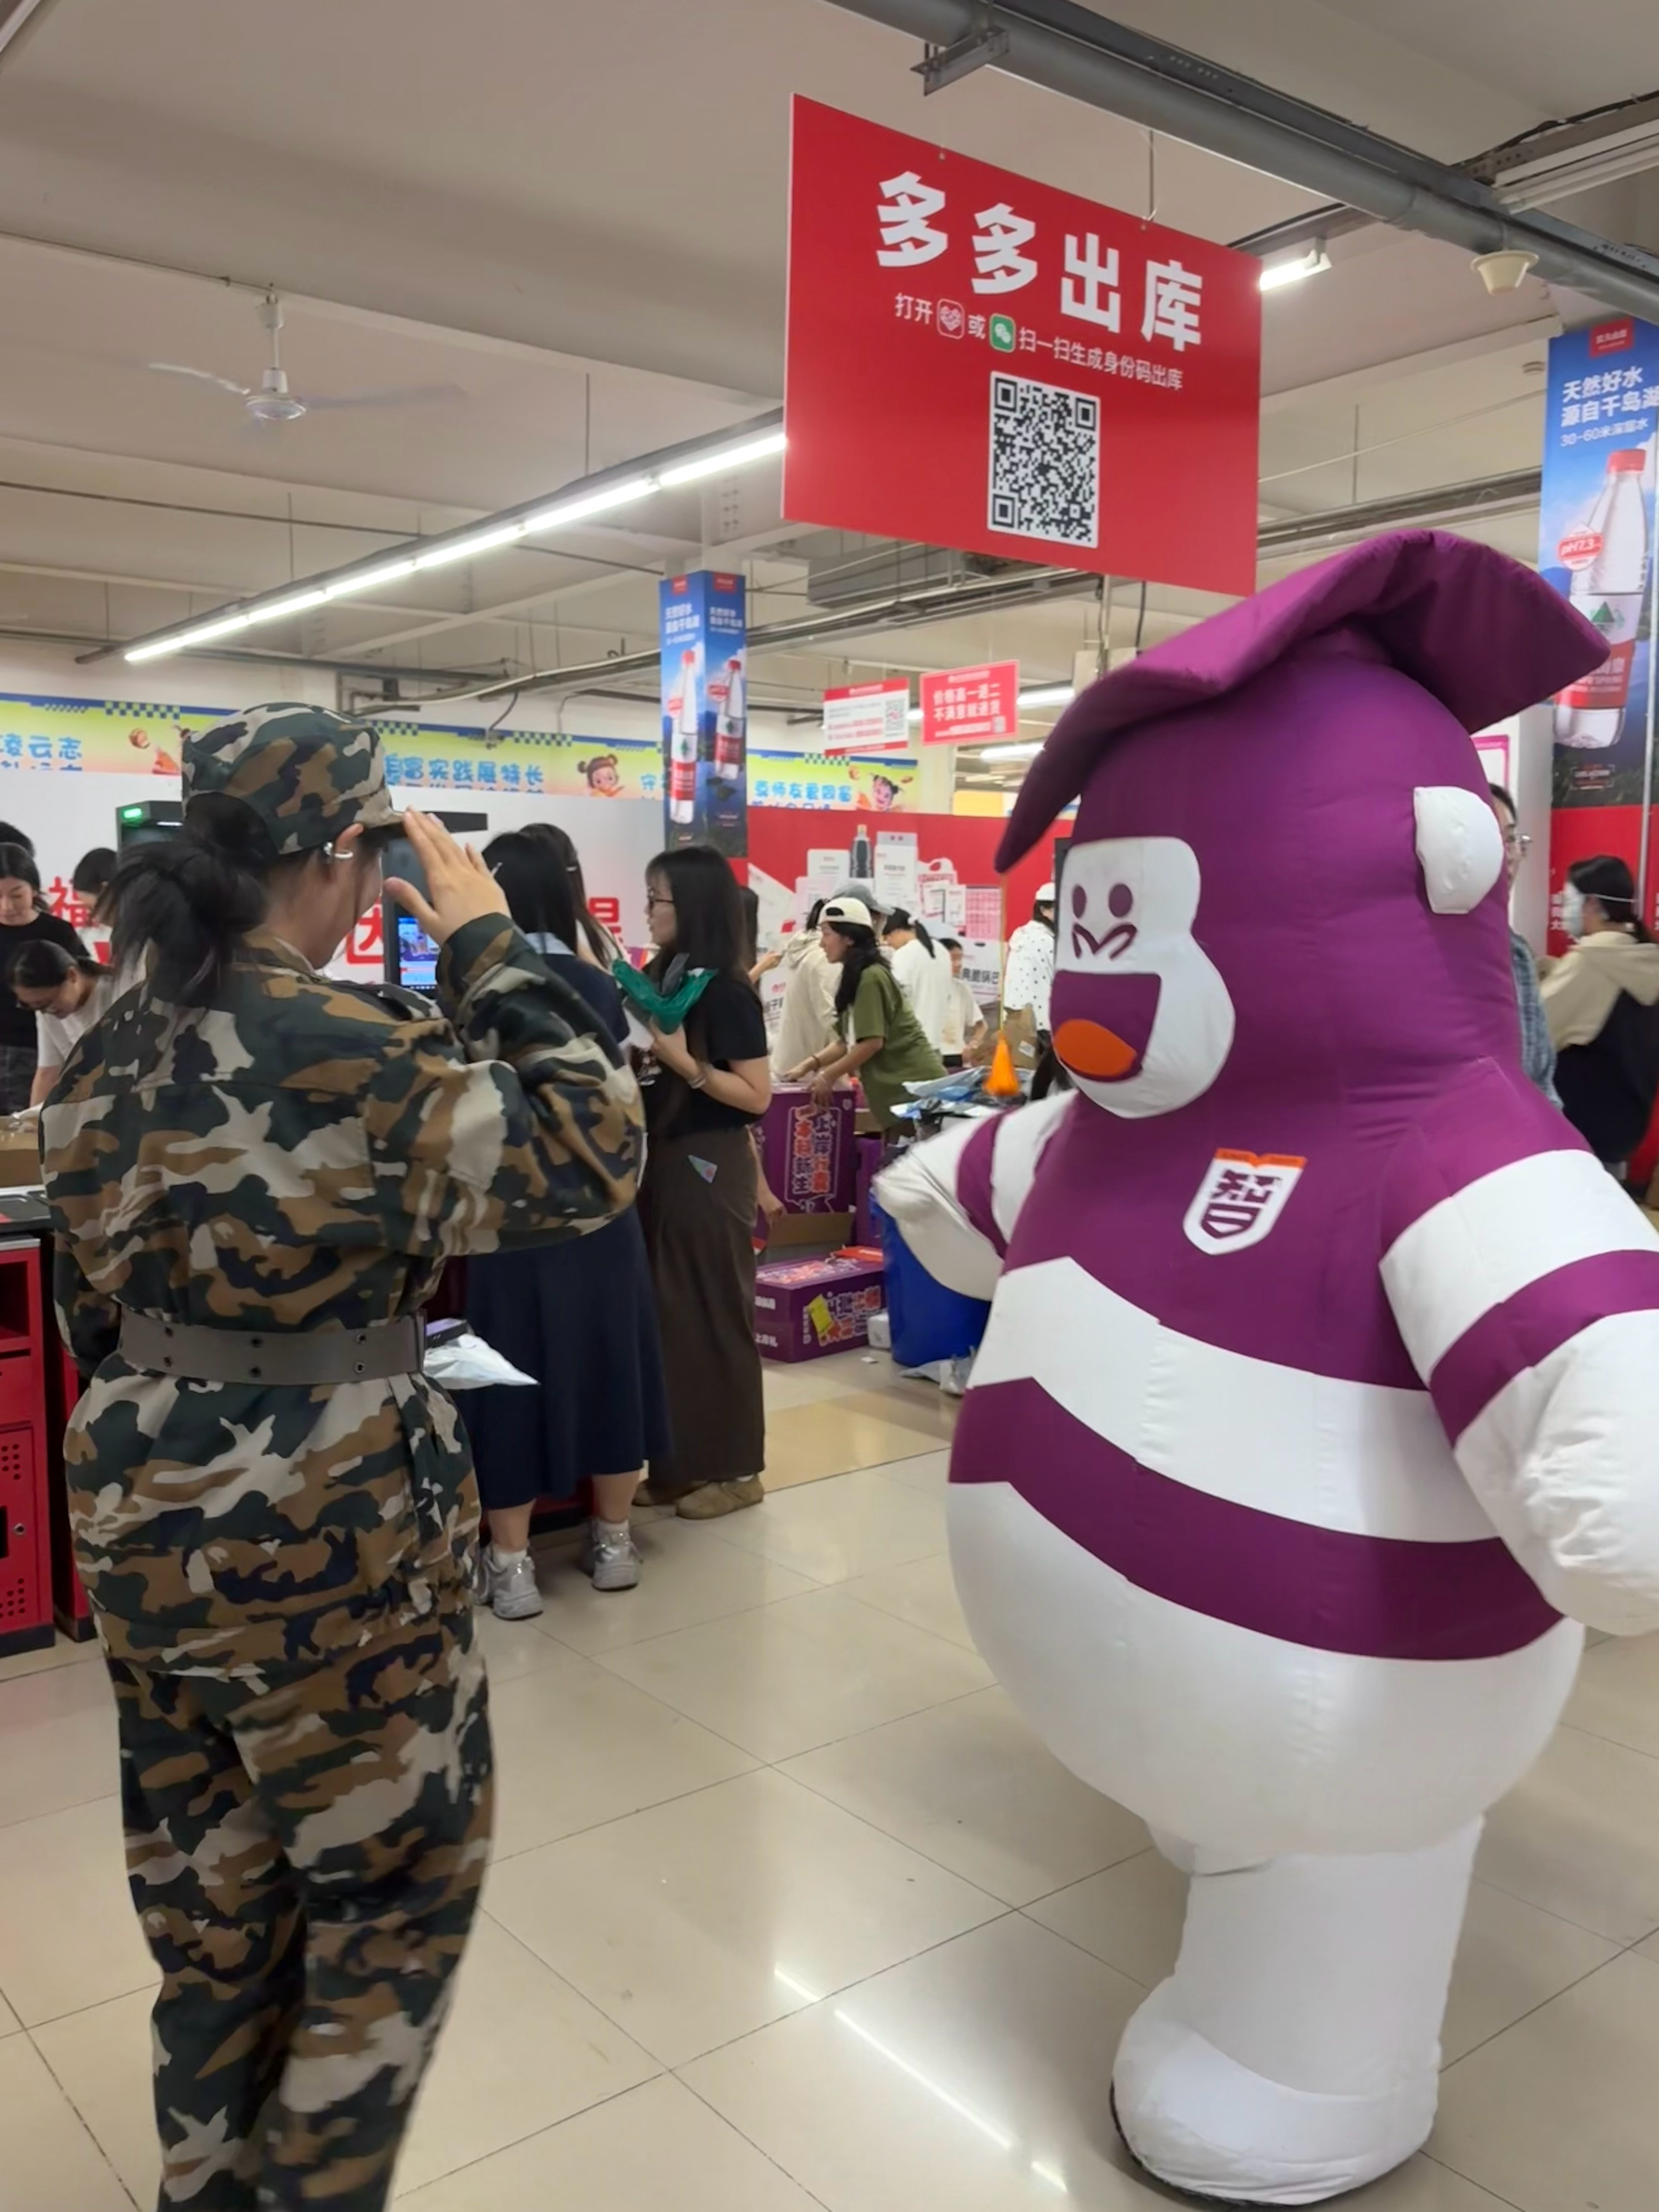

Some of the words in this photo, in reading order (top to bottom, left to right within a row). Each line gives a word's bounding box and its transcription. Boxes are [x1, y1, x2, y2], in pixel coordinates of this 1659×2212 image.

[876, 171, 1203, 352] 多多出库
[894, 292, 933, 325] 打开
[968, 313, 986, 340] 或
[1018, 327, 1183, 391] 扫一扫生成身份码出库
[1562, 366, 1643, 403] 天然好水
